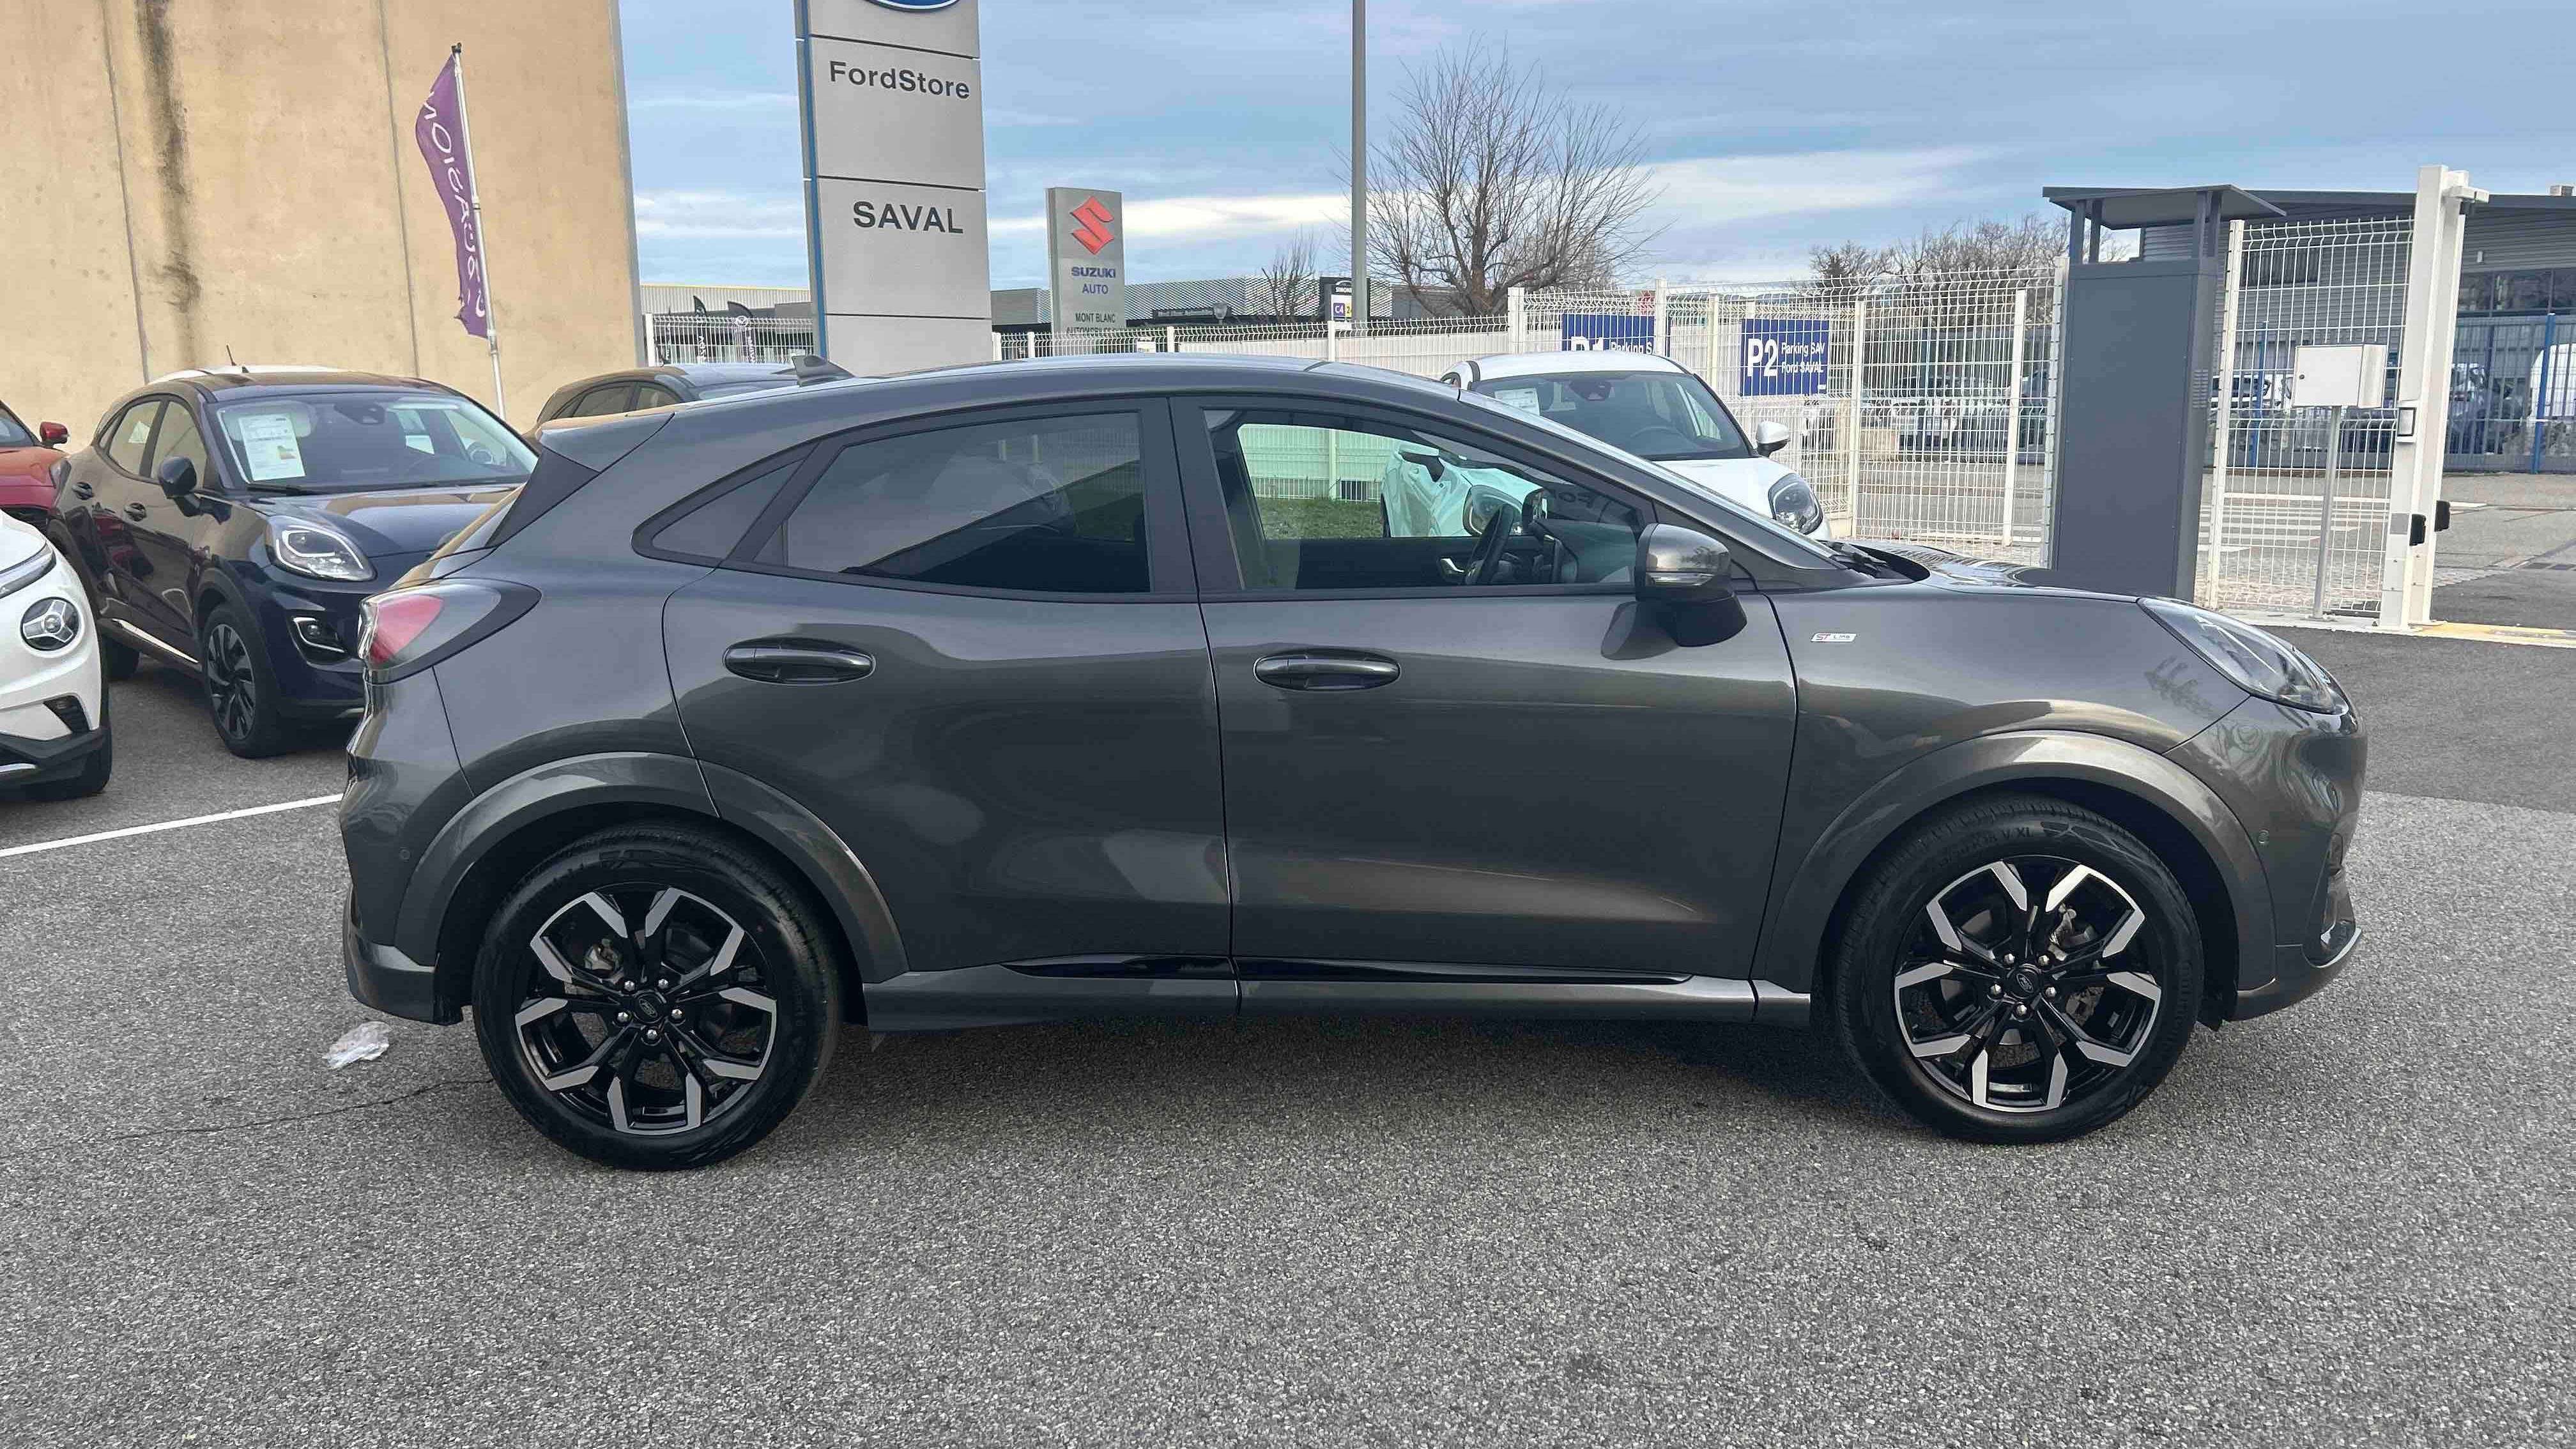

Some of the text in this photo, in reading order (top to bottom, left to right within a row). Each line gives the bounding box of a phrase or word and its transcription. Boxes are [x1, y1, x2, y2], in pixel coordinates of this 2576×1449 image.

[829, 60, 970, 99] FordStore
[853, 201, 963, 234] SAVAL
[1071, 266, 1116, 278] SUZUKI
[1082, 284, 1108, 295] AUTO
[1075, 312, 1116, 323] MONT BLANC
[1781, 342, 1825, 357] Parking SAV
[1747, 338, 1778, 377] P2
[1781, 361, 1823, 374] Ford SAVAL
